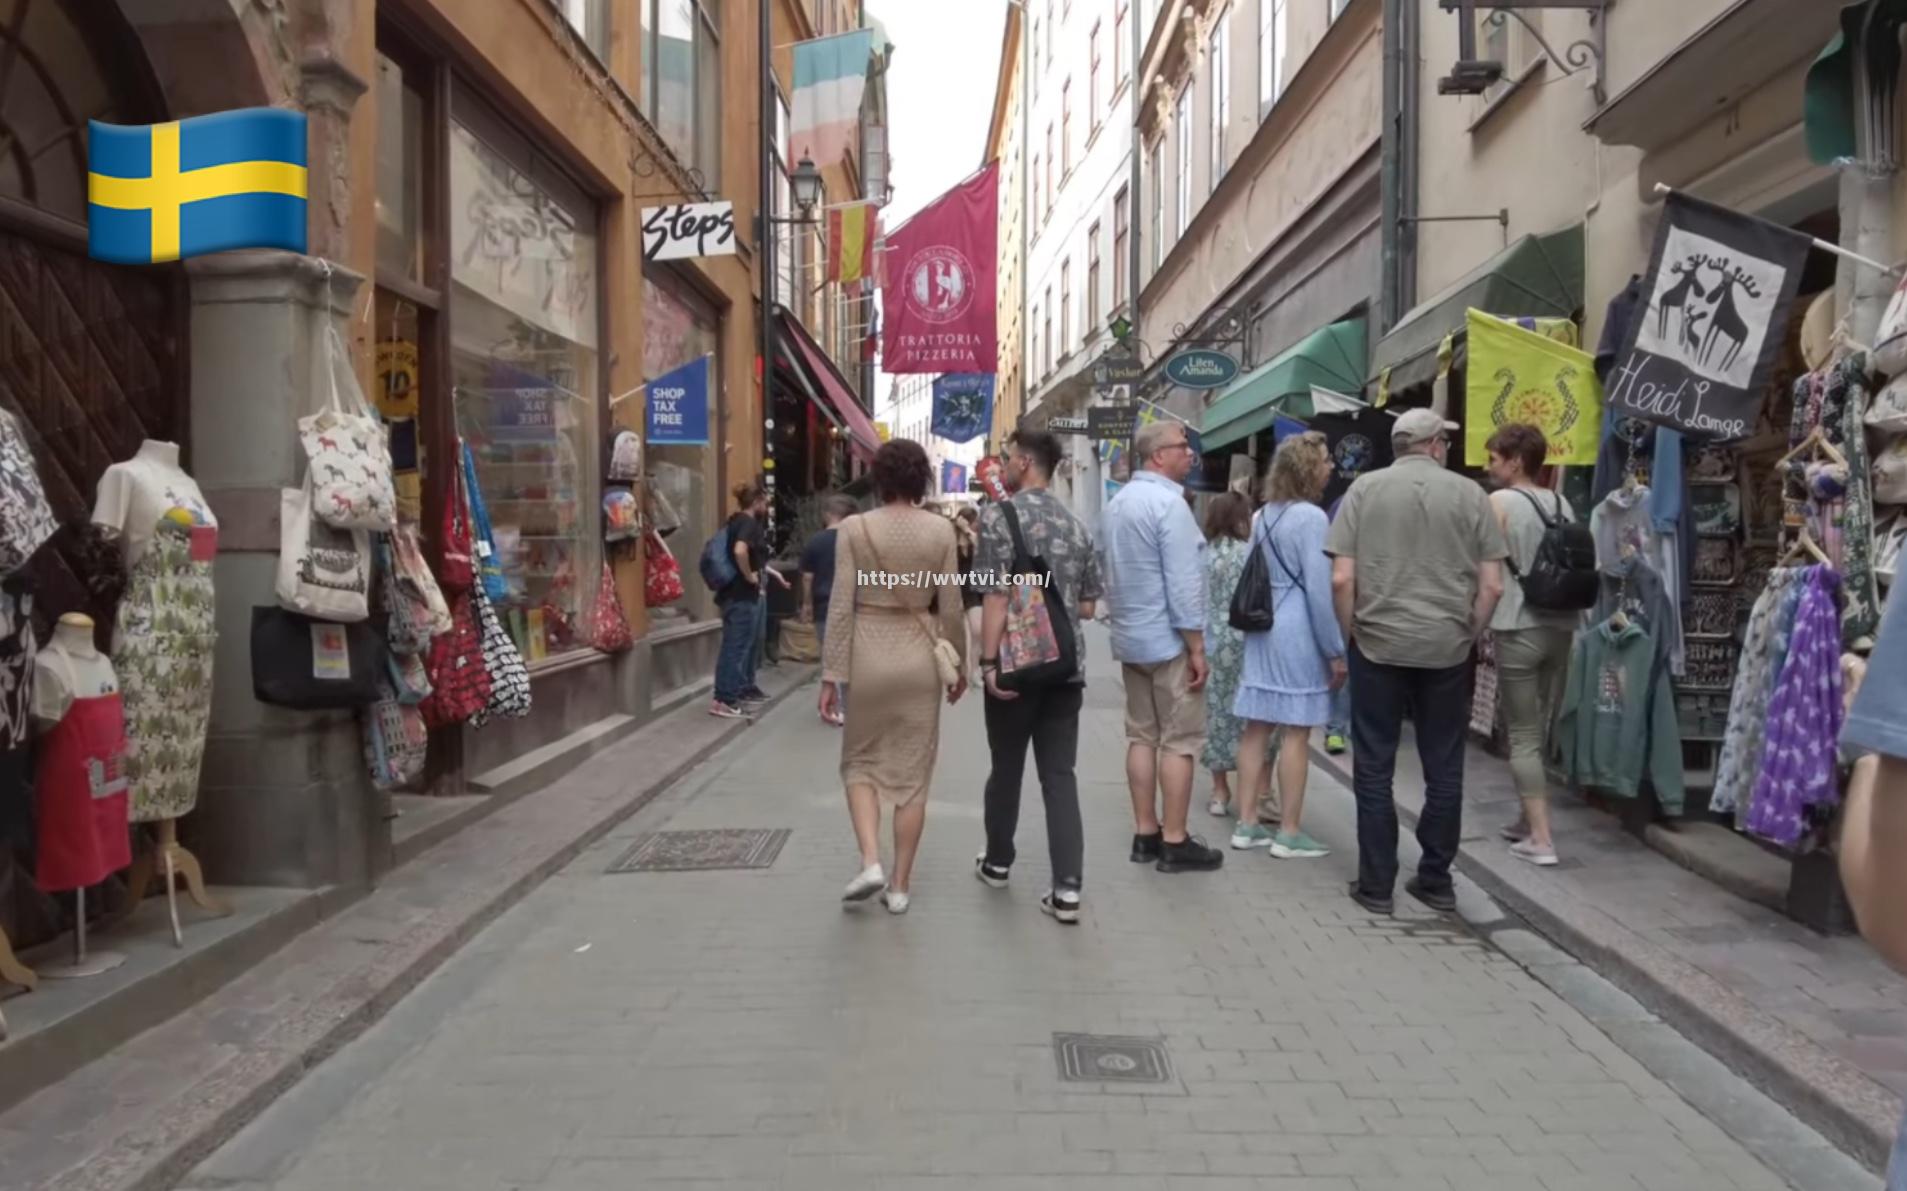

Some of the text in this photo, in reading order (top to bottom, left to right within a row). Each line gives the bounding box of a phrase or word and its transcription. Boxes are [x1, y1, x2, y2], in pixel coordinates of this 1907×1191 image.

[642, 204, 734, 260] Steps
[899, 333, 981, 347] TRATTORIA
[906, 350, 975, 362] PIZZERIA
[1179, 364, 1225, 376] Amanda
[653, 387, 686, 400] SHOP
[1608, 352, 1689, 423] Heidi
[1683, 380, 1745, 443] Lange
[653, 400, 677, 412] TAX
[653, 413, 683, 425] FREE
